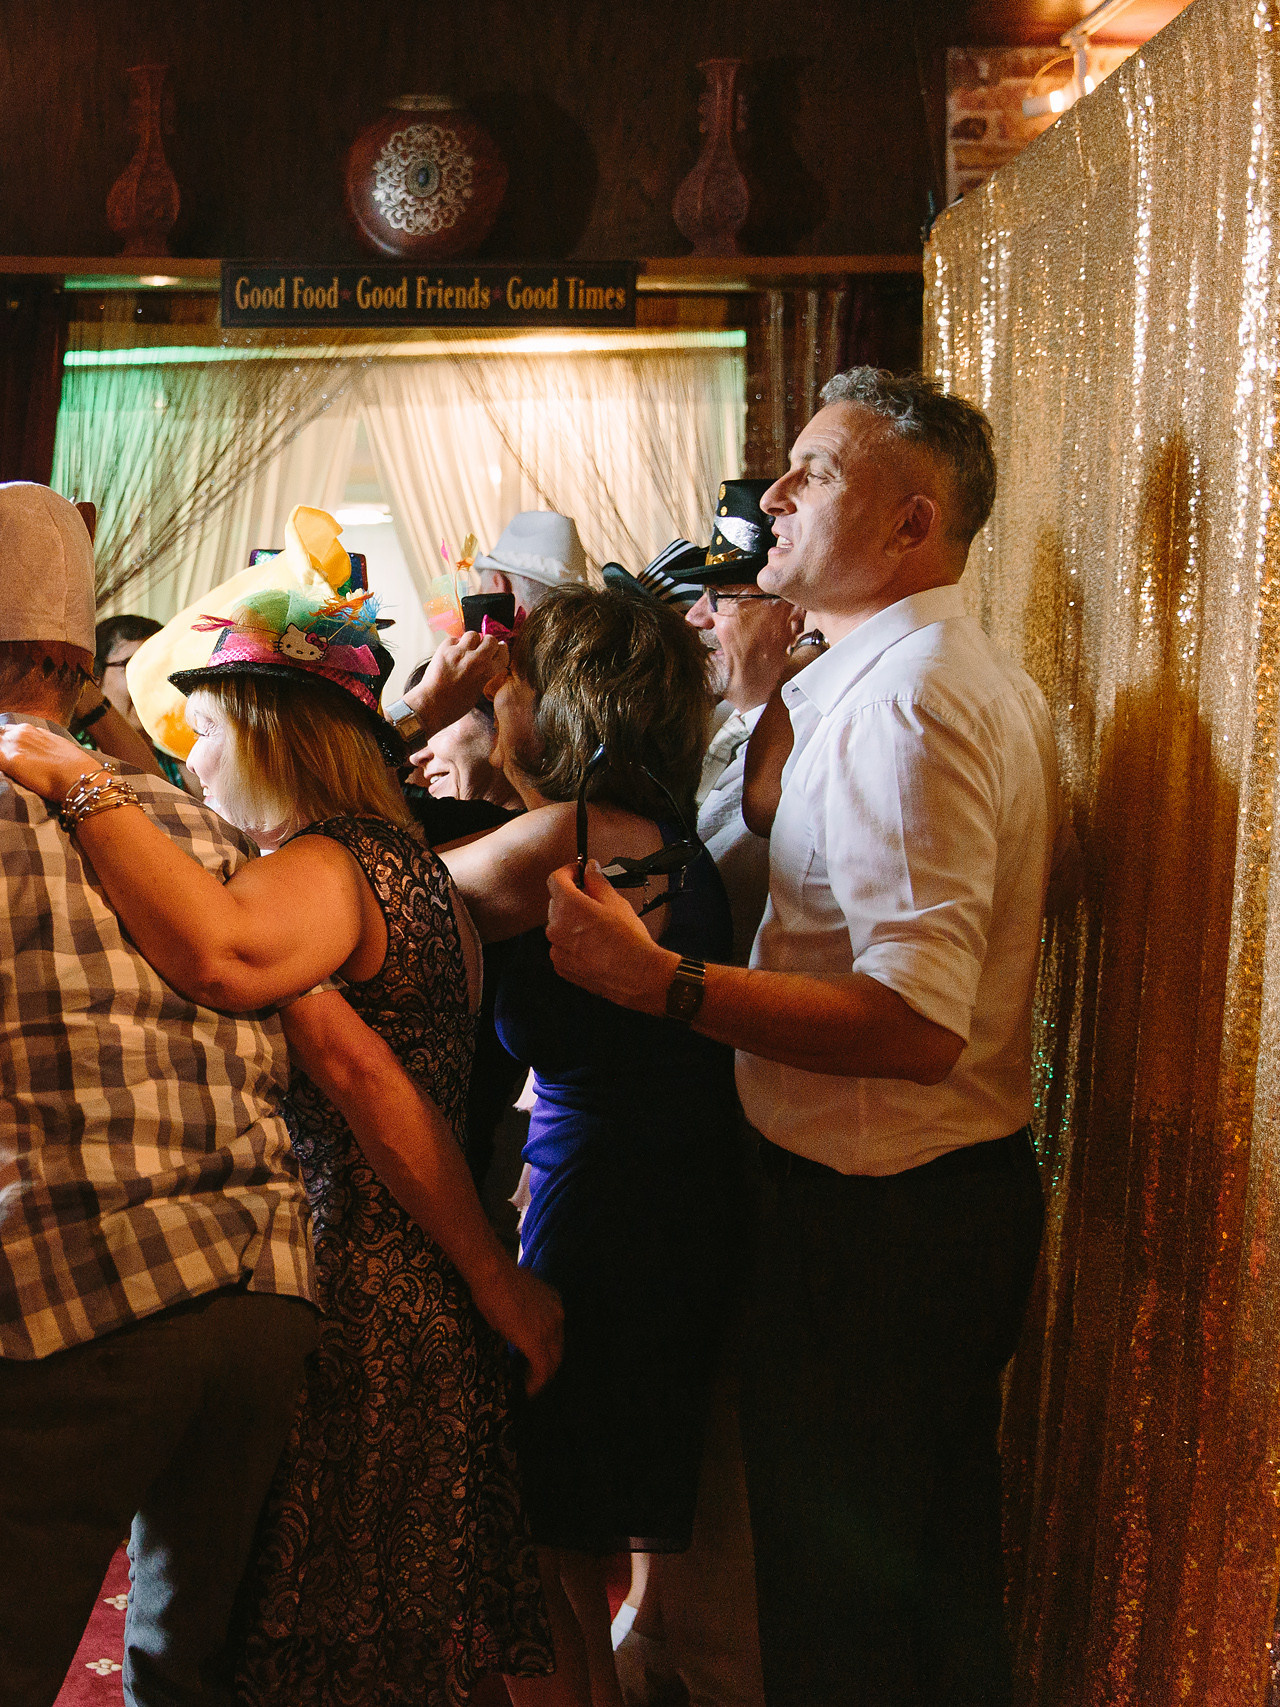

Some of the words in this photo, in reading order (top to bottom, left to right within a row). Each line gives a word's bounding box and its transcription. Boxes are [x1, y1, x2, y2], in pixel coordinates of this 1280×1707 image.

[235, 275, 286, 310] Good
[291, 276, 339, 310] Food
[356, 275, 408, 310] Good
[416, 275, 491, 310] Friends
[506, 275, 559, 310] Good
[564, 276, 626, 310] Times
